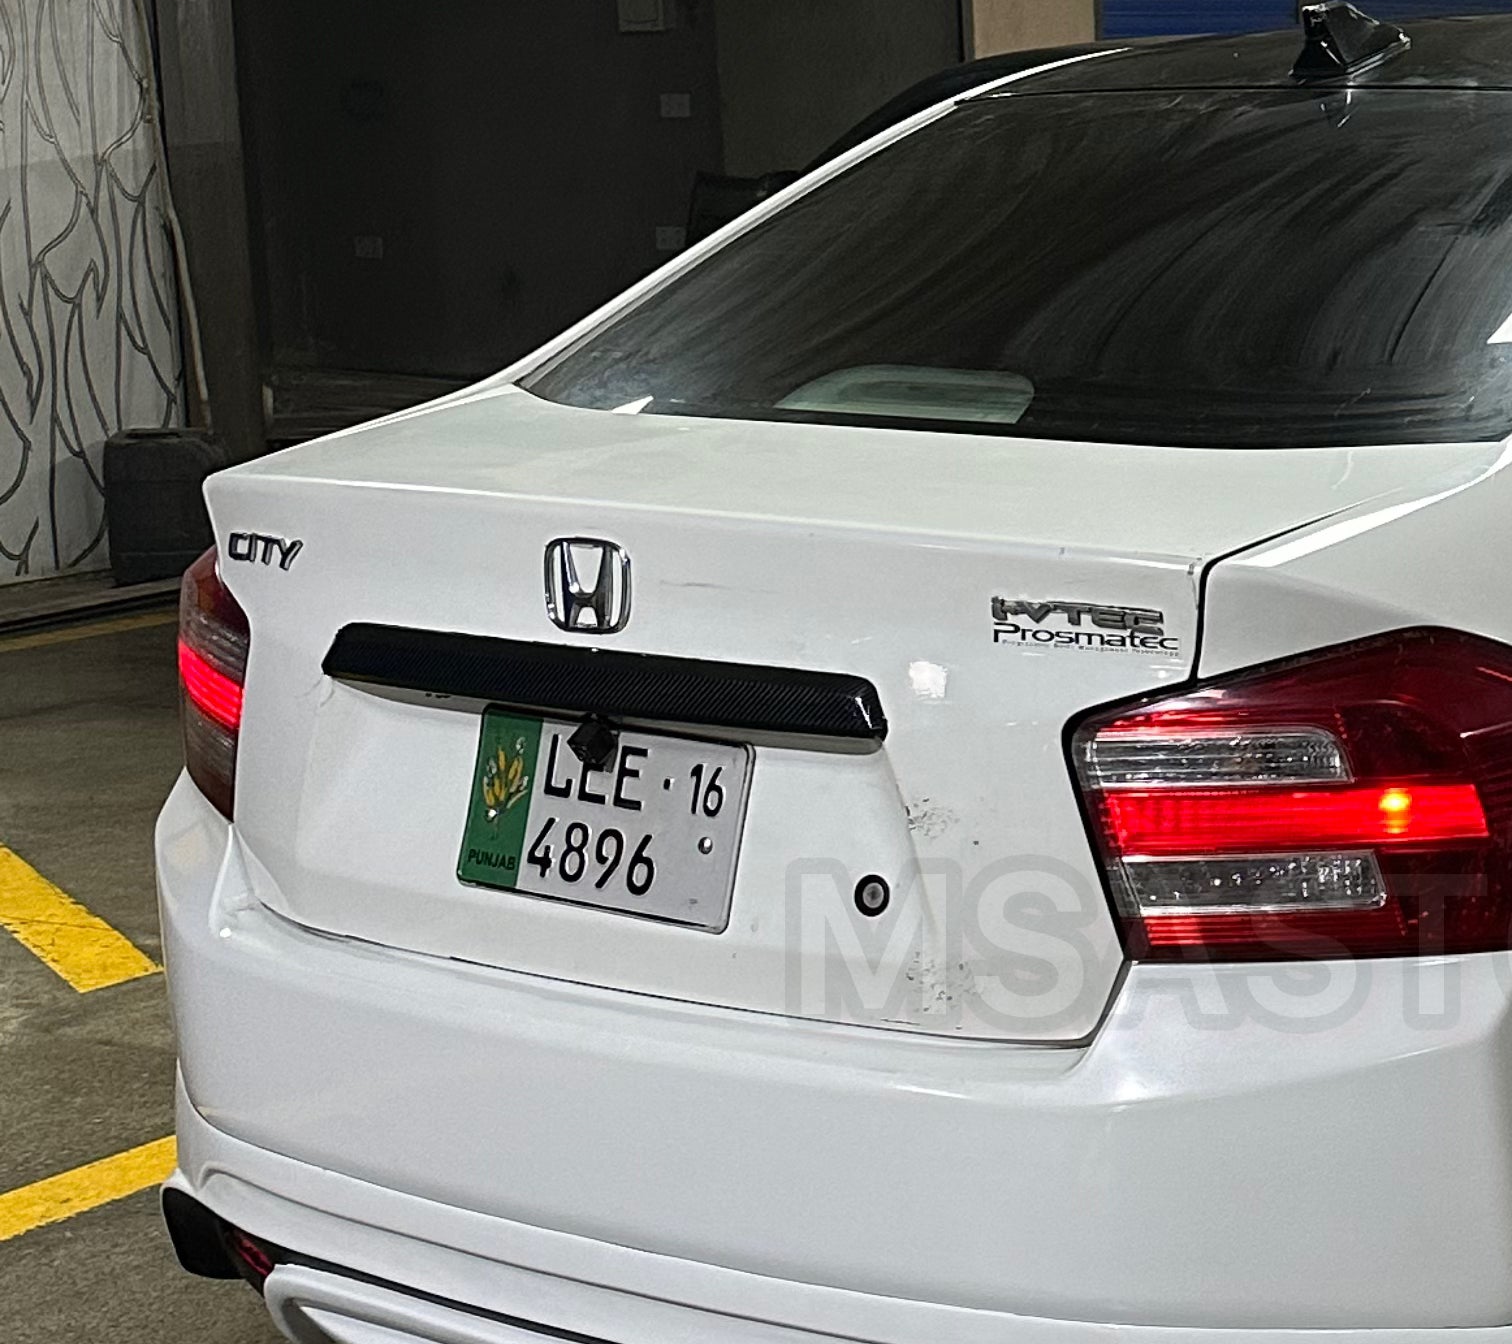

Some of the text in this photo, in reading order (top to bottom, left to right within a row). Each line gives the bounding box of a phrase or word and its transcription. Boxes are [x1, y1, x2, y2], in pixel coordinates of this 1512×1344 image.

[228, 532, 303, 571] CITY
[993, 621, 1180, 651] Prosmatec
[543, 733, 725, 818] LEE 16
[467, 847, 517, 872] PUNJAB
[527, 816, 655, 896] 4896
